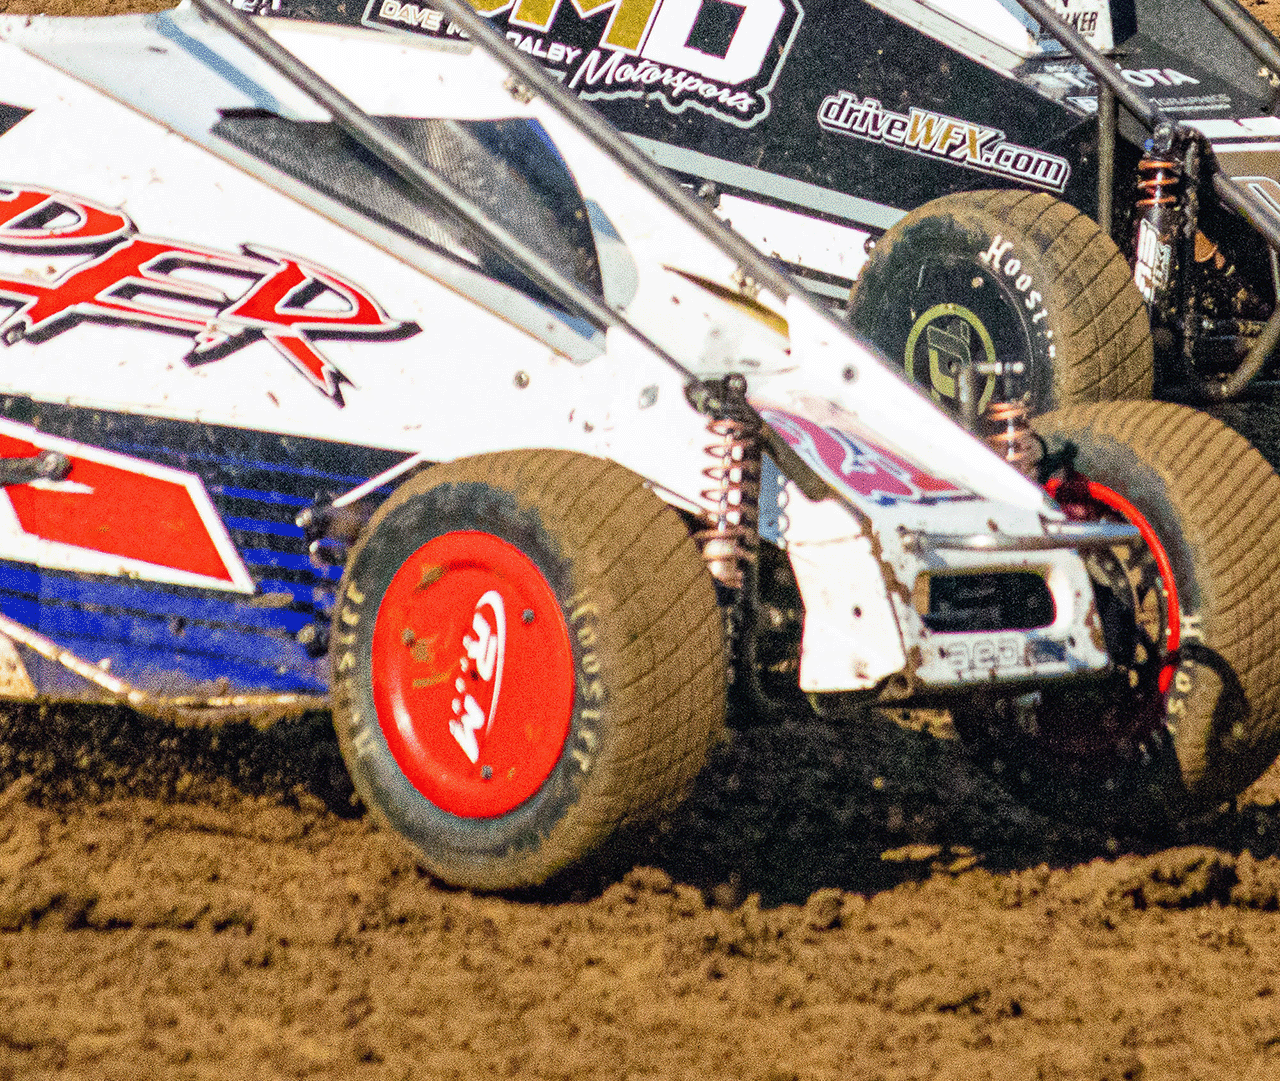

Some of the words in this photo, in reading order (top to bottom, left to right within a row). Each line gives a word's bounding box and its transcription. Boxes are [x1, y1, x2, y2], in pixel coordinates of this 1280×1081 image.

[379, 0, 444, 31] DAVE
[572, 51, 758, 113] Motorsports
[824, 94, 1067, 189] driveWFX.com
